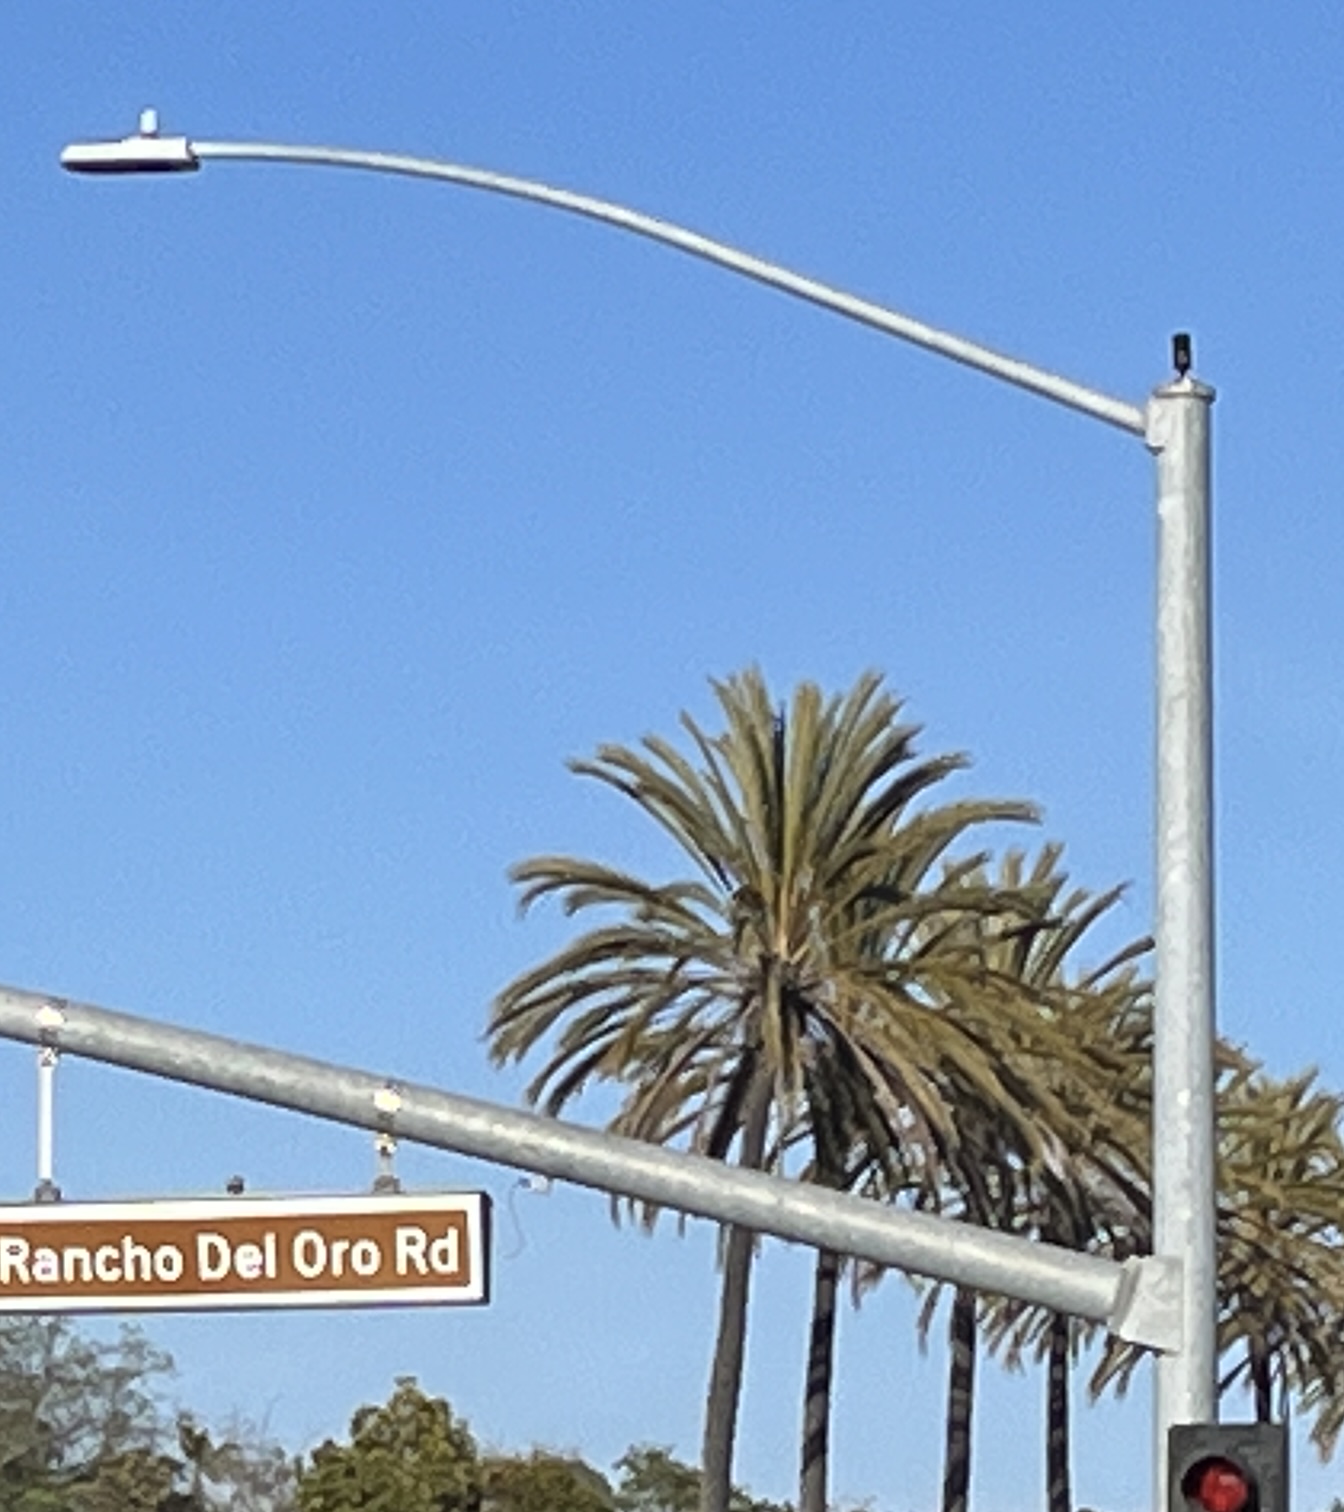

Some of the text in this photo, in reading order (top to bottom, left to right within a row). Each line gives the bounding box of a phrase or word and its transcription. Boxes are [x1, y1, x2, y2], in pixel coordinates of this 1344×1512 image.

[195, 1231, 277, 1281] Del
[292, 1229, 381, 1278] Oro
[394, 1225, 460, 1276] Rd
